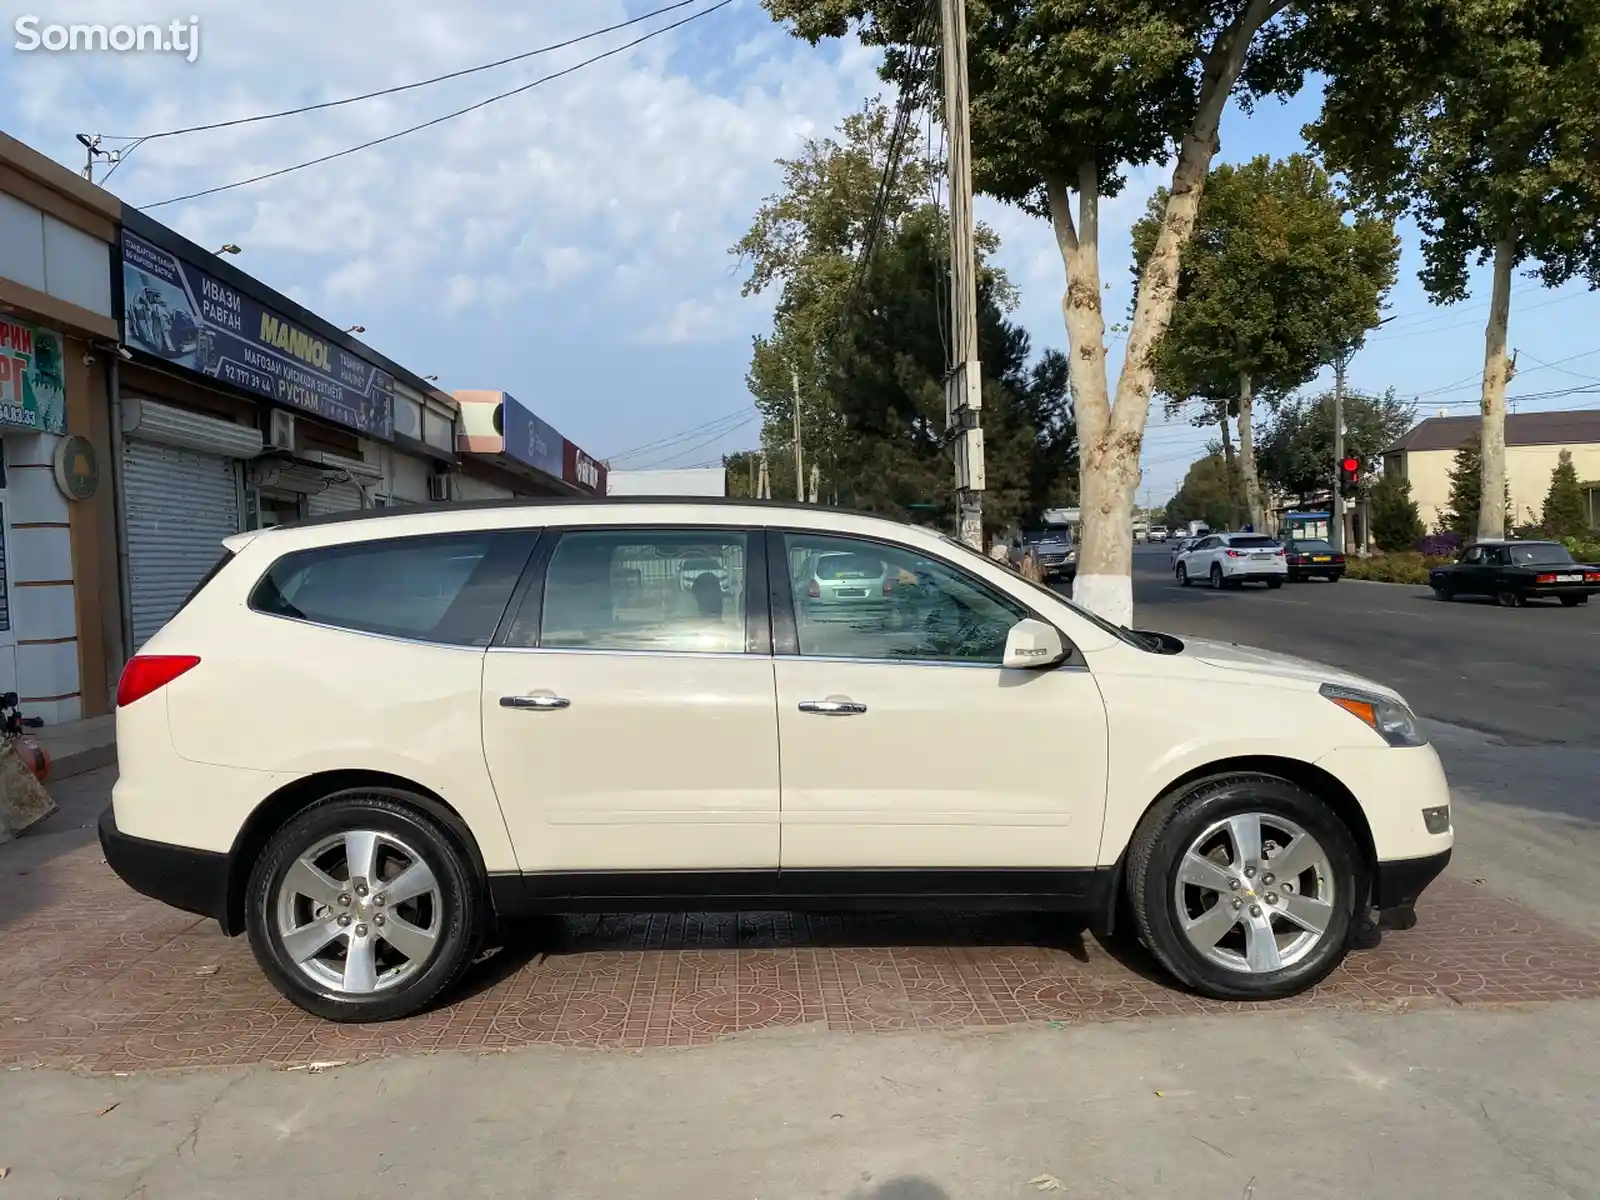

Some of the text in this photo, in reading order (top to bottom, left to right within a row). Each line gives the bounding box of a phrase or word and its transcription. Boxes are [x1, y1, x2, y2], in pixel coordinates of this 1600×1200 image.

[202, 277, 240, 313] ИВАЗИ
[260, 311, 331, 373] MANNOL
[279, 379, 319, 411] РУСТАМ
